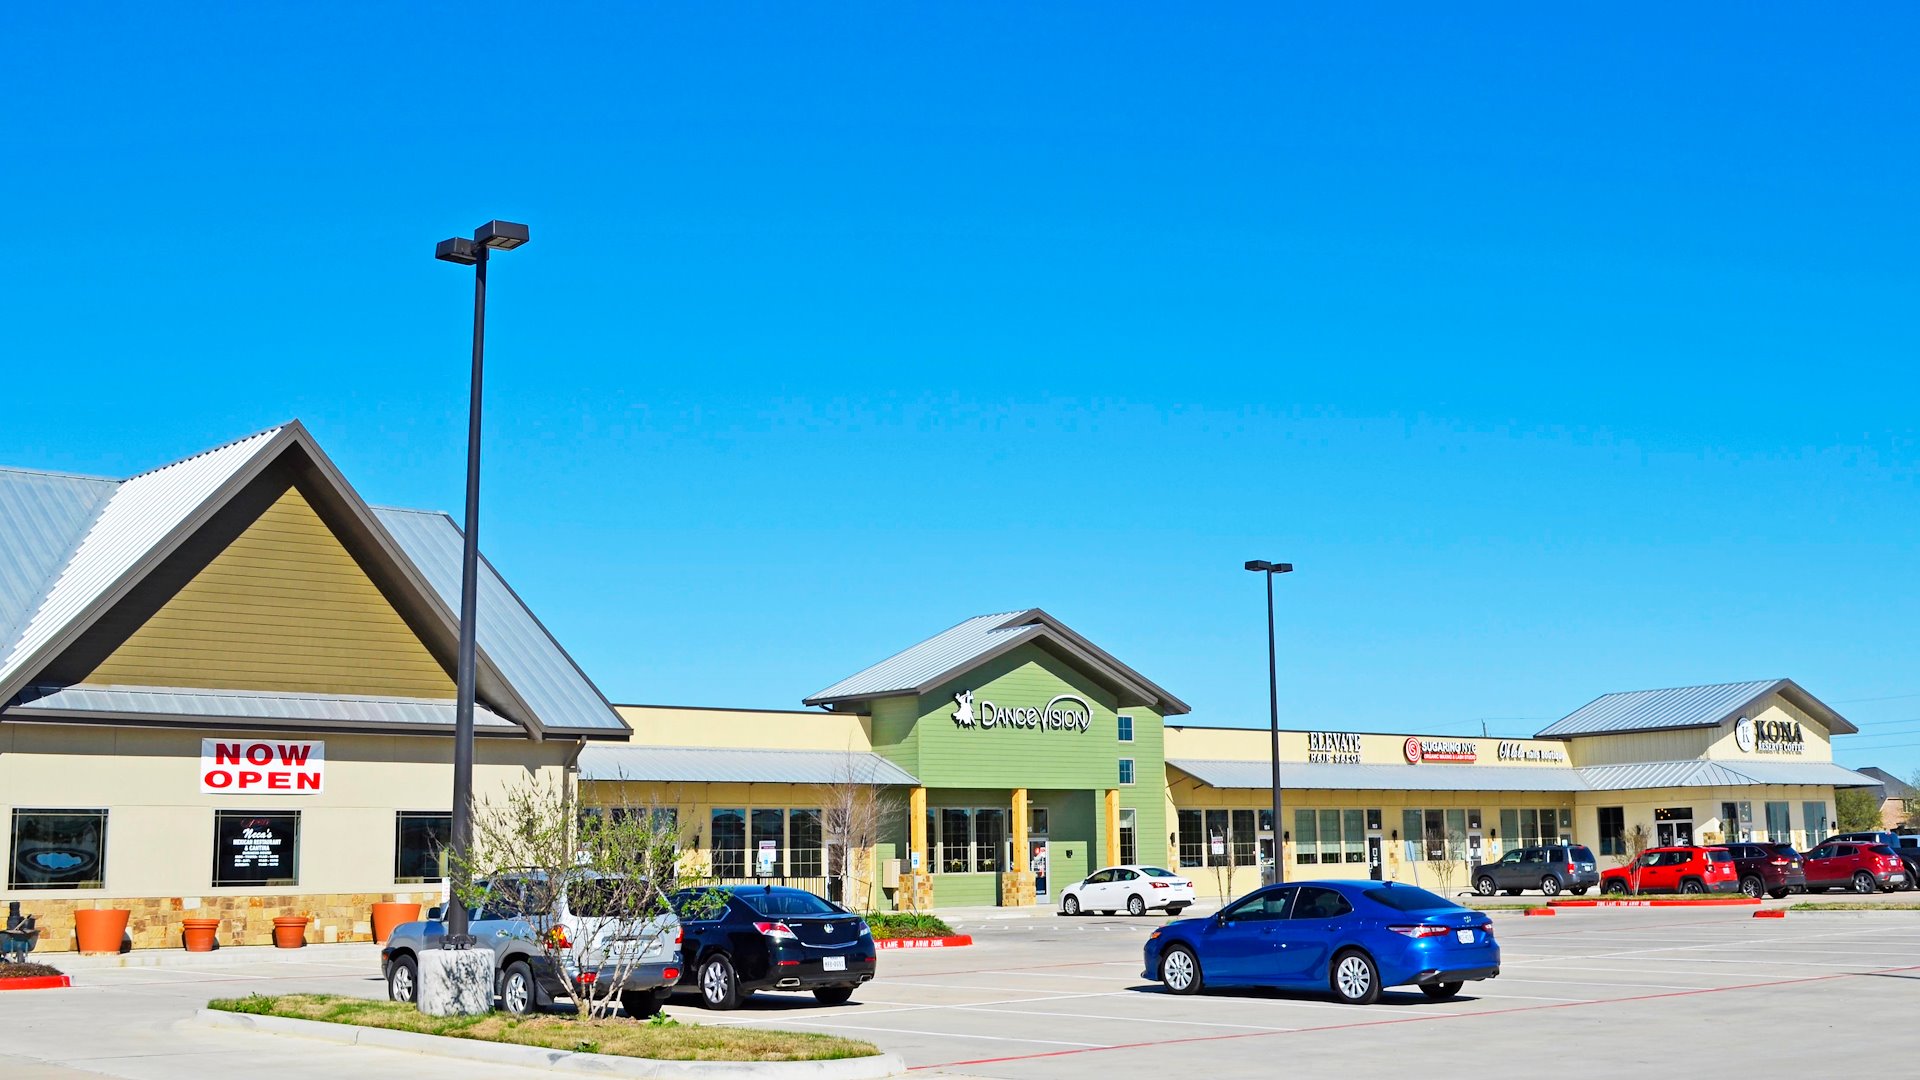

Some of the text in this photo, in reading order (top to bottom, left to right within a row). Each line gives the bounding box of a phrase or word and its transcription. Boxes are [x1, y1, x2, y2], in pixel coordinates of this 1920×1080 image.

[1756, 720, 1804, 743] KONA
[1309, 732, 1361, 752] ELEVATE
[1421, 741, 1478, 753] SUGARING NYC
[1758, 741, 1805, 752] RESERVE COFFEE
[215, 743, 311, 766] NOW
[1310, 753, 1361, 763] HAIR SALON
[204, 770, 321, 789] OPEN
[883, 940, 899, 949] LANE
[903, 940, 914, 948] TOW
[915, 939, 929, 947] AWAY
[931, 939, 944, 947] ZONE
